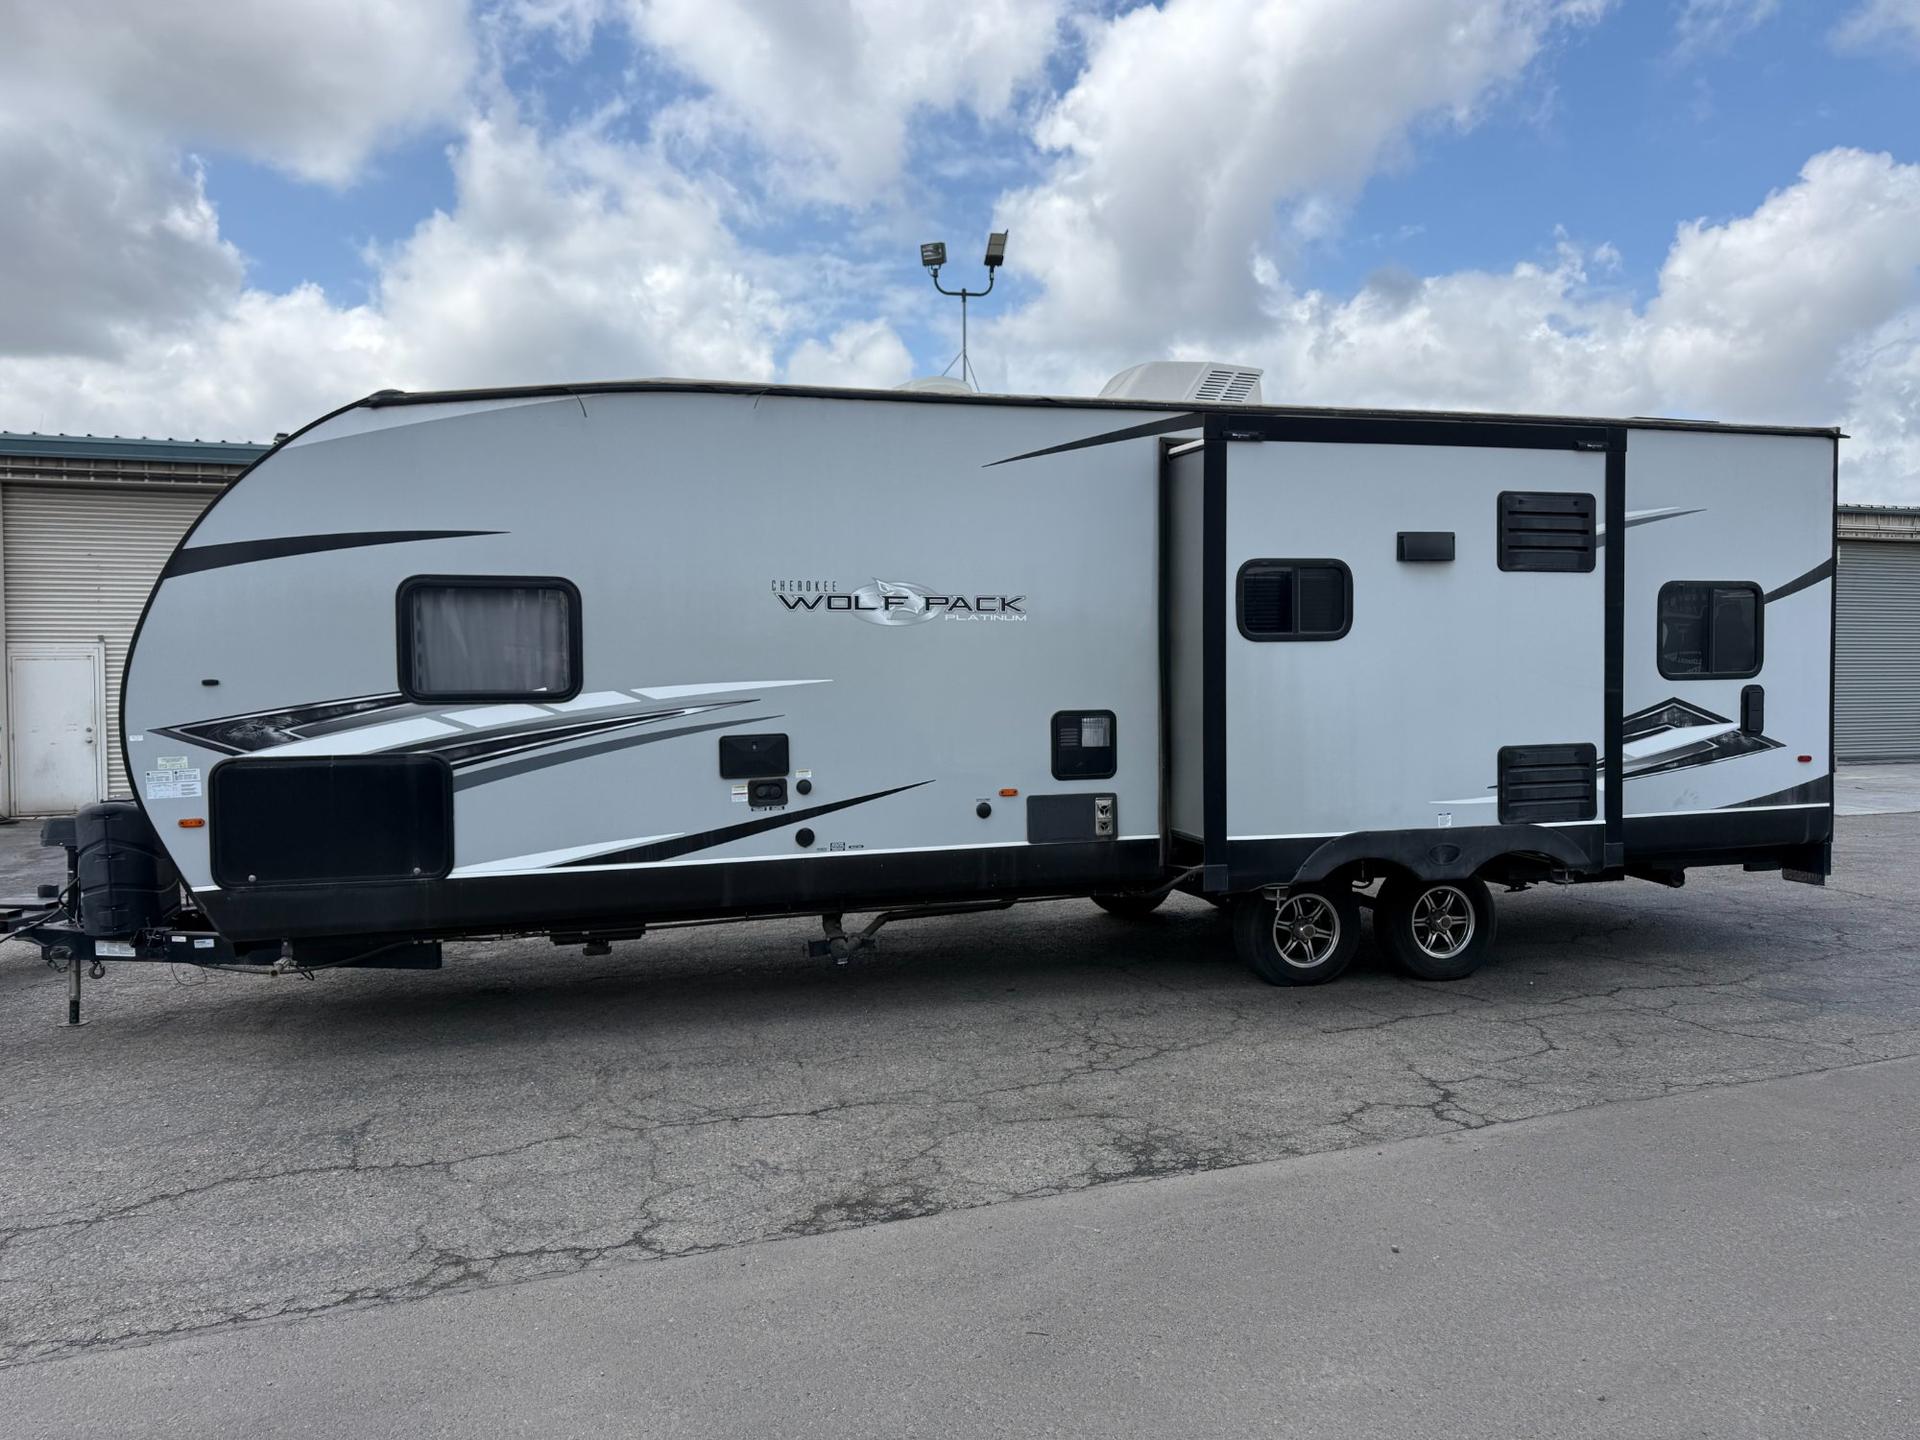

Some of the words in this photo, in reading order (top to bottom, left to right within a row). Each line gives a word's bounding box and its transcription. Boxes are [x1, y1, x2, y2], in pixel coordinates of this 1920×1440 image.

[771, 580, 837, 592] CHEROKEE
[776, 594, 909, 611] WOLF
[923, 595, 1026, 612] PACK
[944, 614, 1027, 622] PLATINUM
